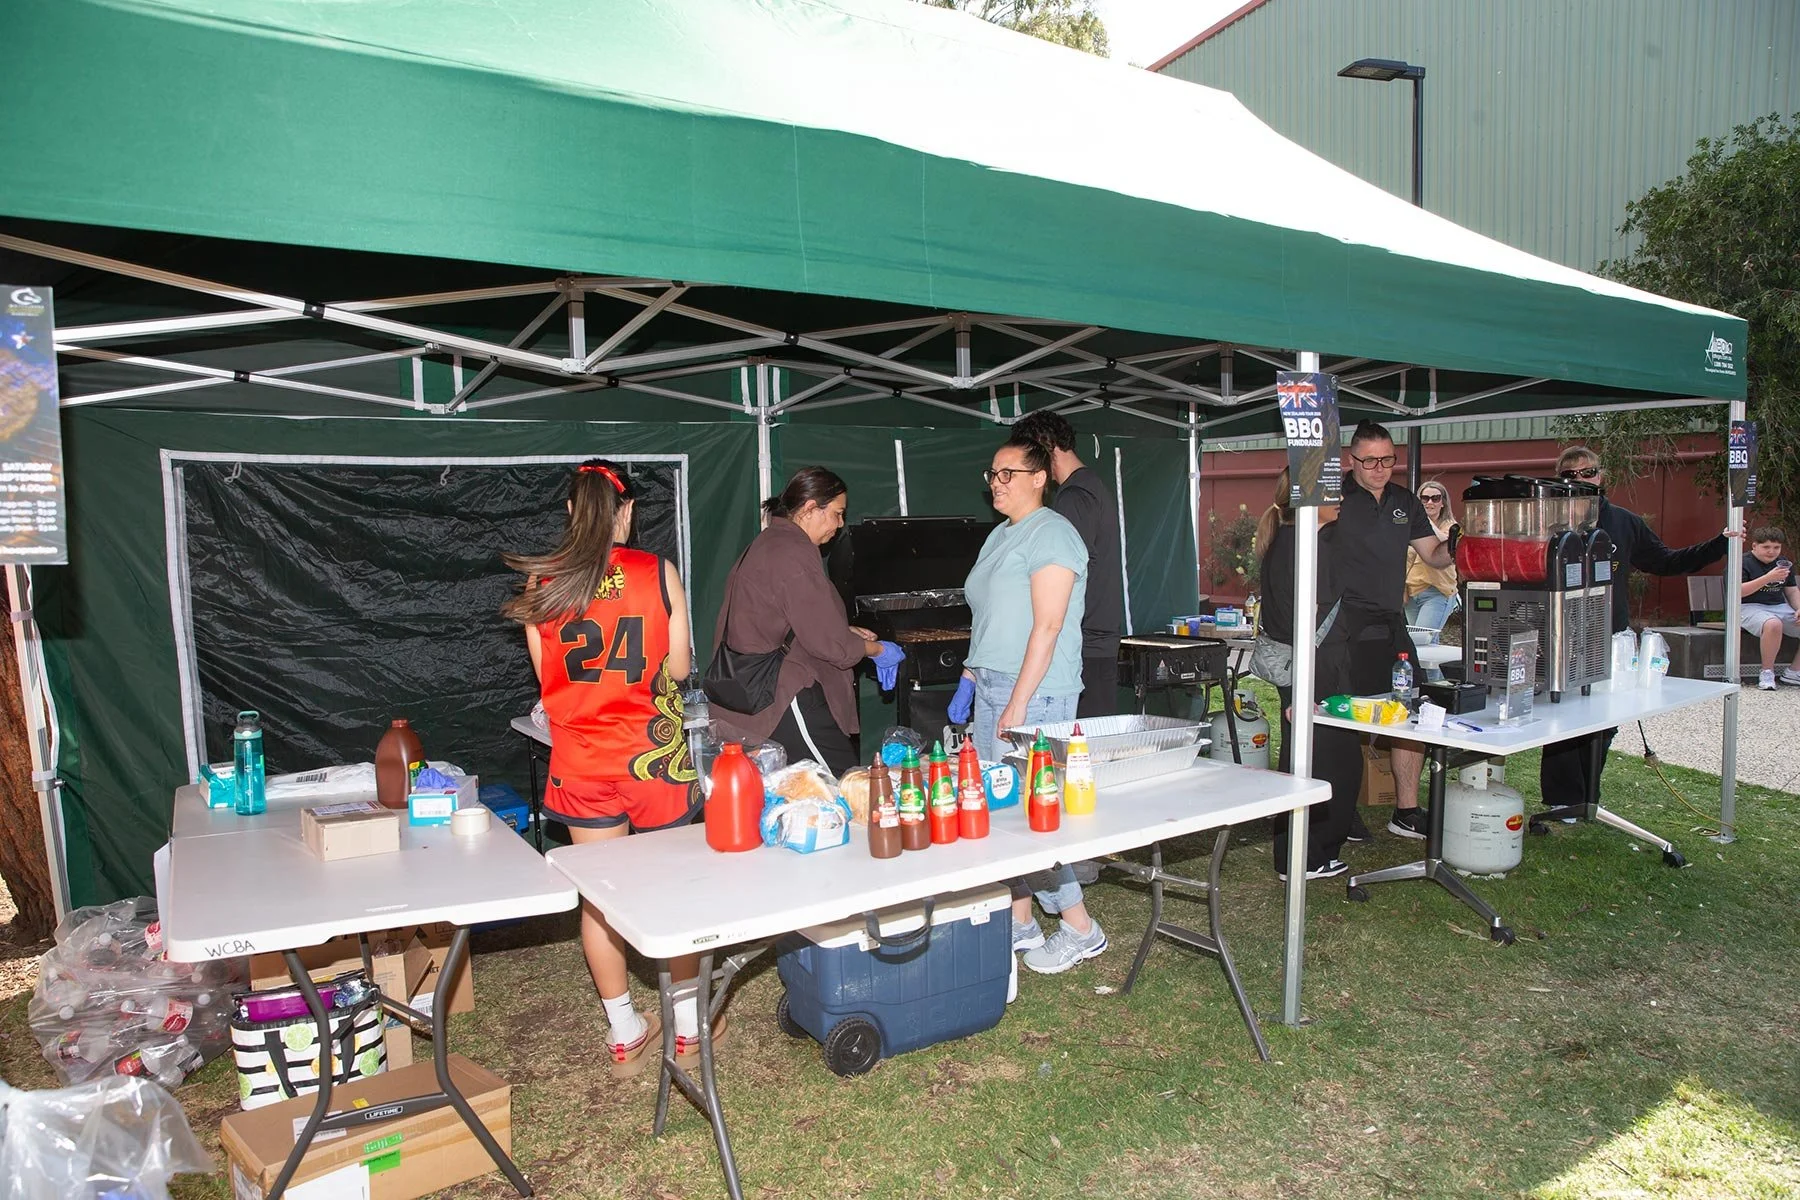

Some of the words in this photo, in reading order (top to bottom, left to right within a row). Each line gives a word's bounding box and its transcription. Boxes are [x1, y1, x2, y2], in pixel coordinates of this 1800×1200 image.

[1284, 418, 1323, 440] BBQ
[1730, 450, 1748, 464] BBQ
[2, 462, 52, 471] SATURDAY
[559, 616, 648, 686] 24
[1511, 668, 1526, 680] BBQ
[204, 940, 256, 958] WCBA
[369, 1108, 398, 1118] LIFETIME
